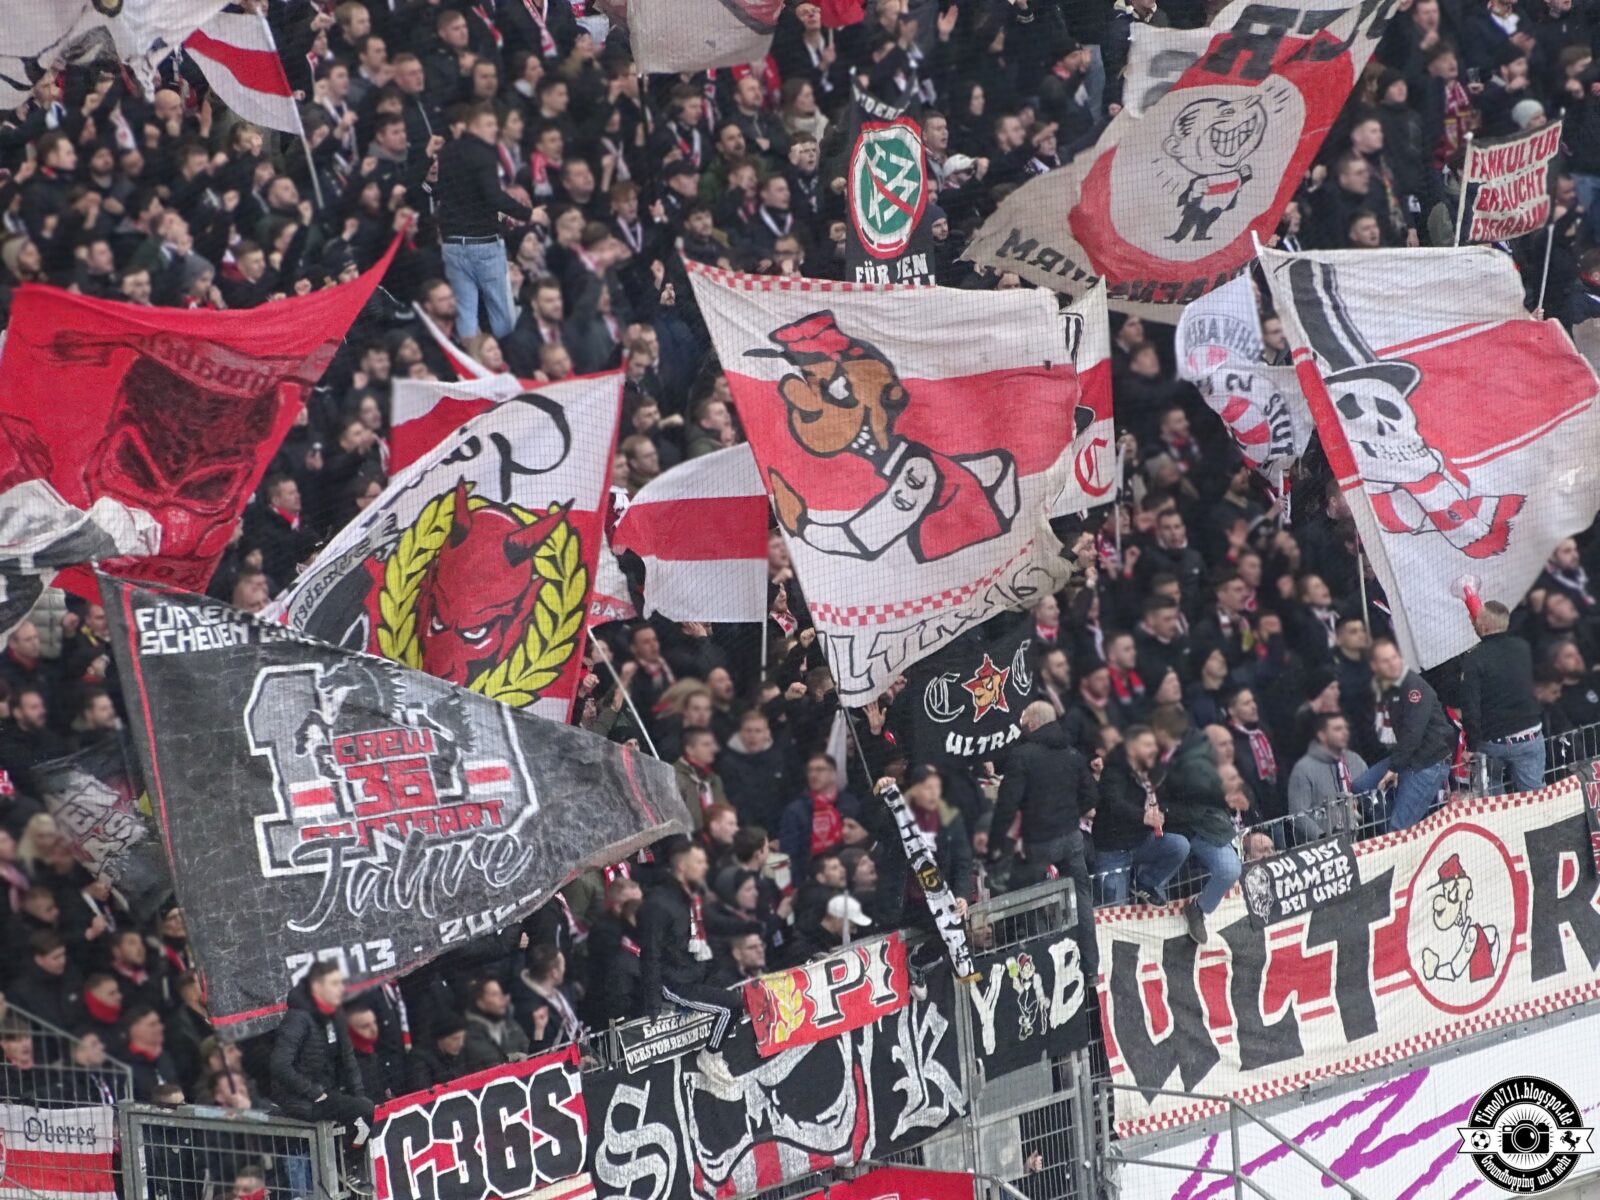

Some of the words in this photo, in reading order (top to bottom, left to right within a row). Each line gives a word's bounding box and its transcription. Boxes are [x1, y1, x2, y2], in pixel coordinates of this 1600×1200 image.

[1476, 167, 1545, 212] BRAUCHT
[135, 603, 192, 631] FÜR
[141, 622, 250, 655] SCHEUEN
[345, 756, 438, 817] 36
[1266, 856, 1297, 879] DU
[1298, 838, 1342, 866] BIST
[1275, 855, 1351, 899] IMMER
[1280, 893, 1307, 915] BEI
[1312, 873, 1354, 904] UNS!
[23, 1116, 97, 1146] Oberes
